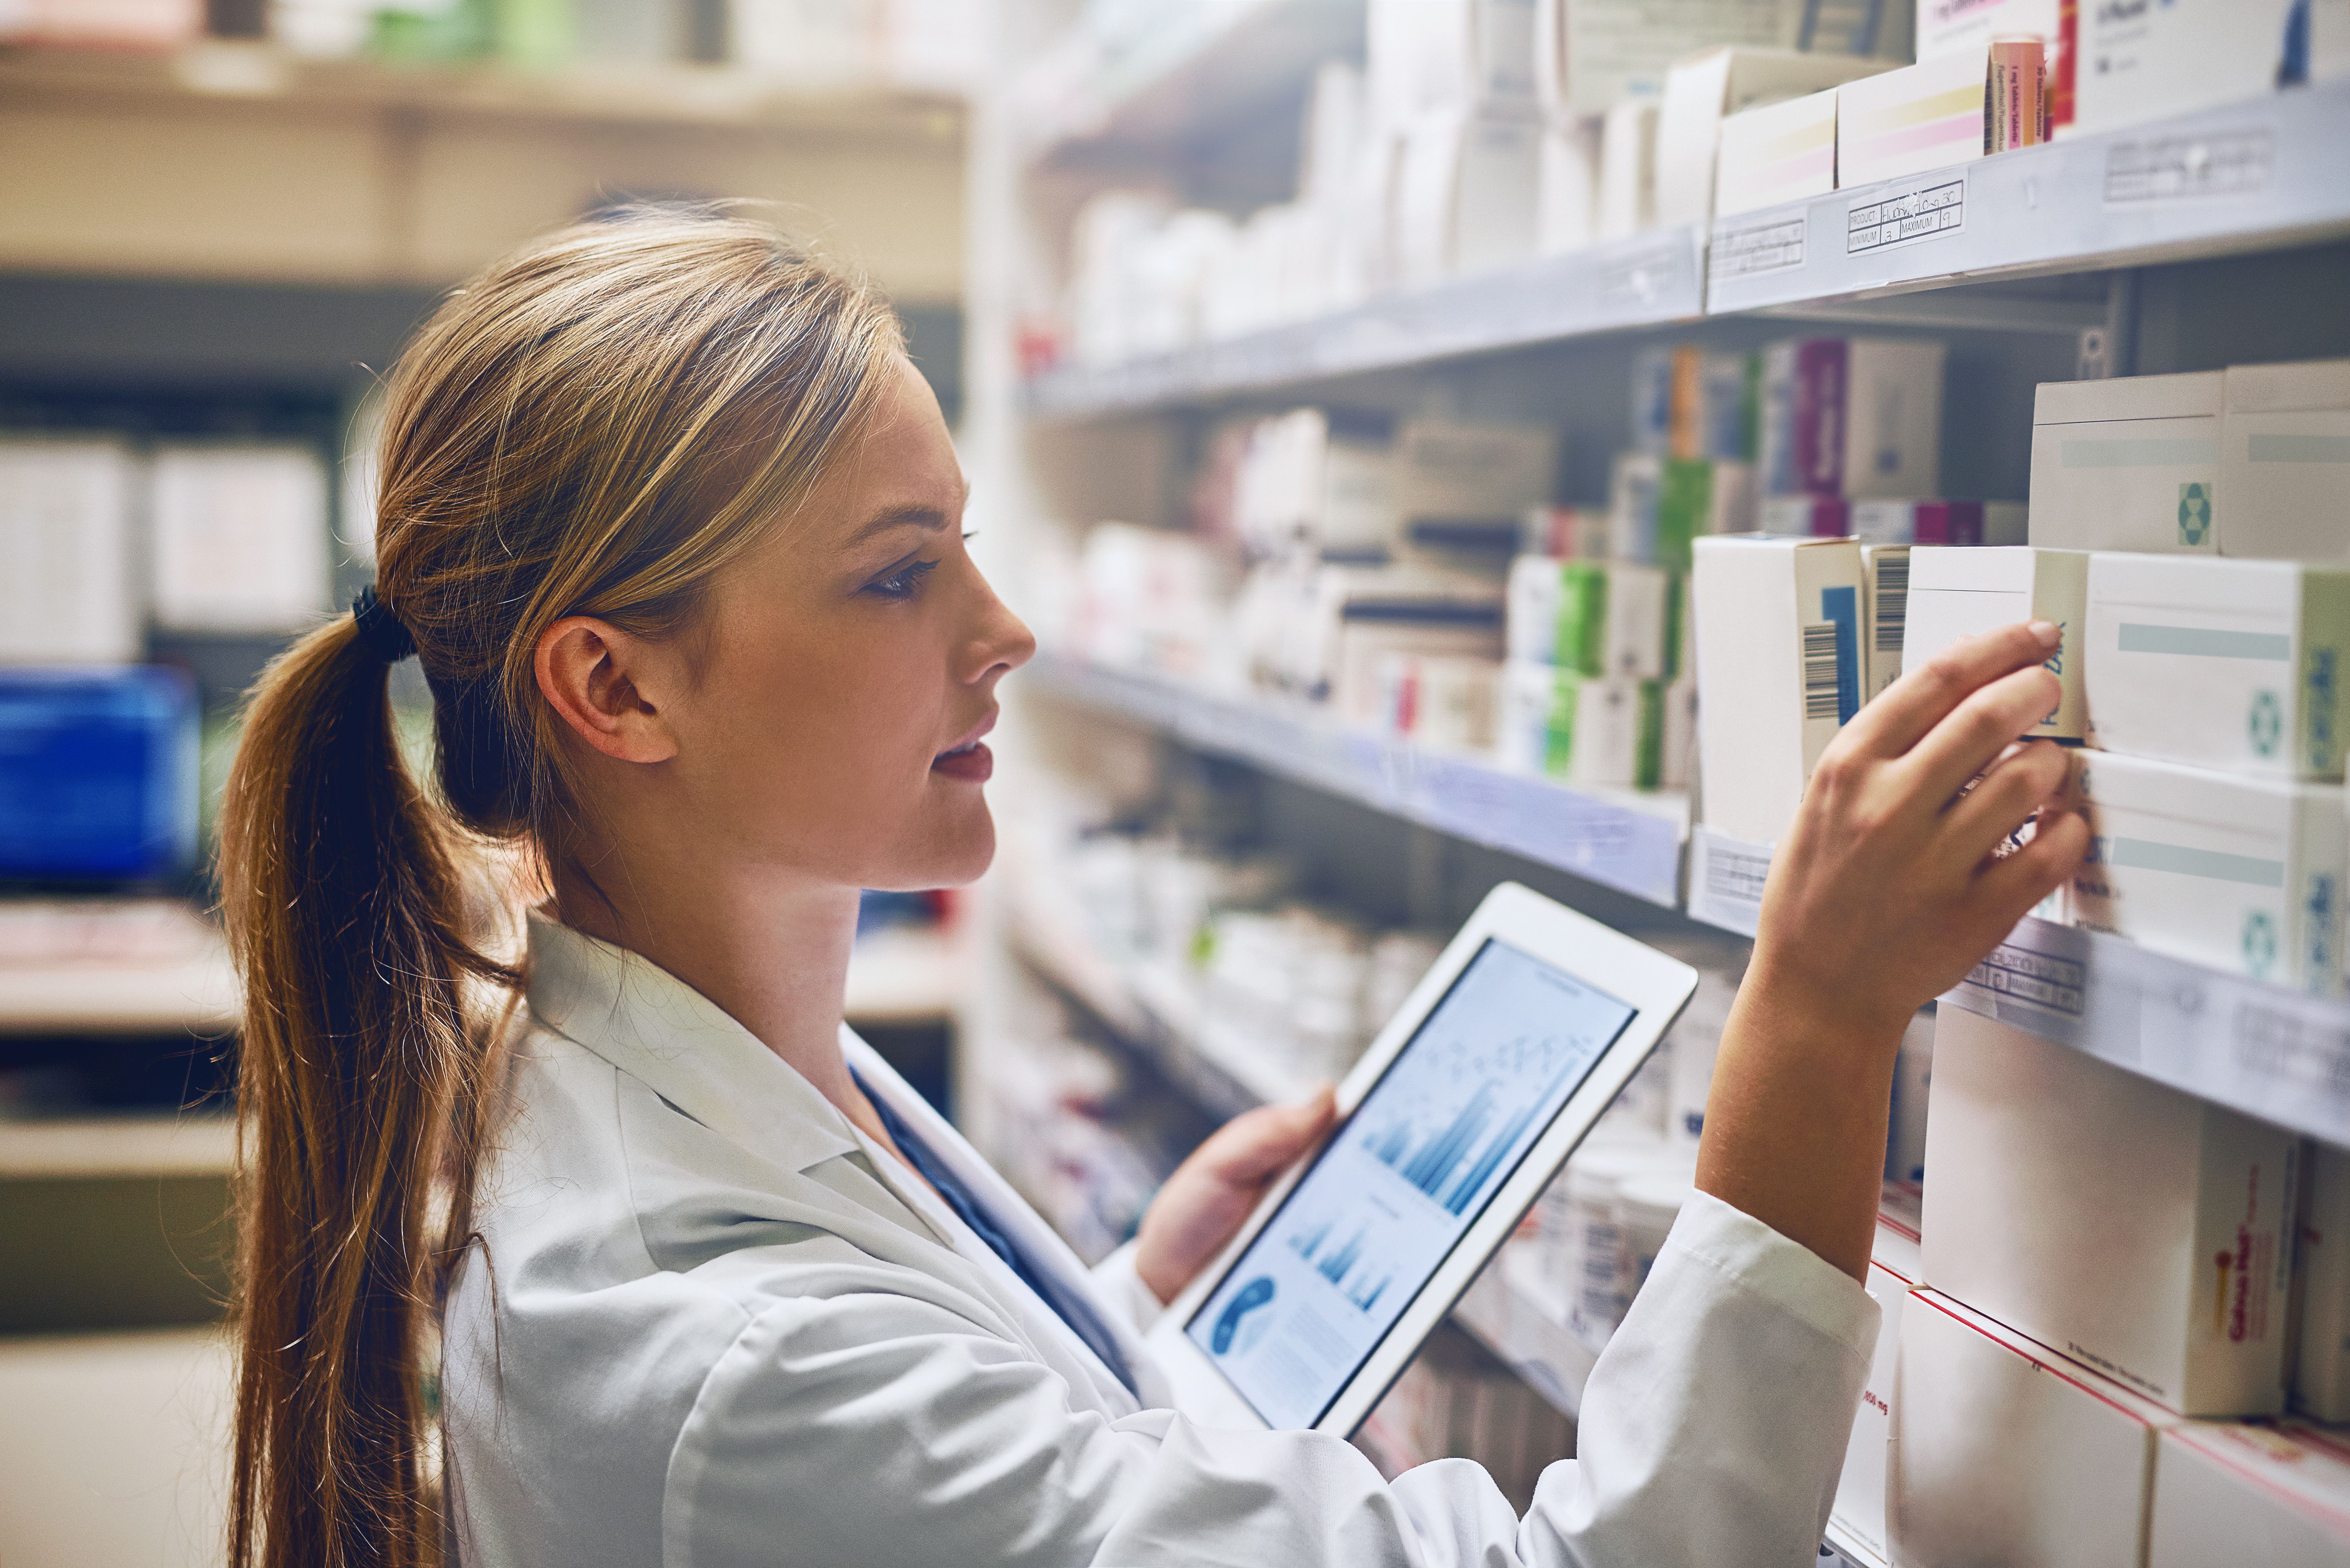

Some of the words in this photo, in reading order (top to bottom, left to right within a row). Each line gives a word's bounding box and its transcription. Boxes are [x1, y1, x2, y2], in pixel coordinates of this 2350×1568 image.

[1901, 216, 1932, 234] MAXIMUM
[1849, 231, 1877, 247] MINIMUM
[1884, 231, 1892, 243] 3
